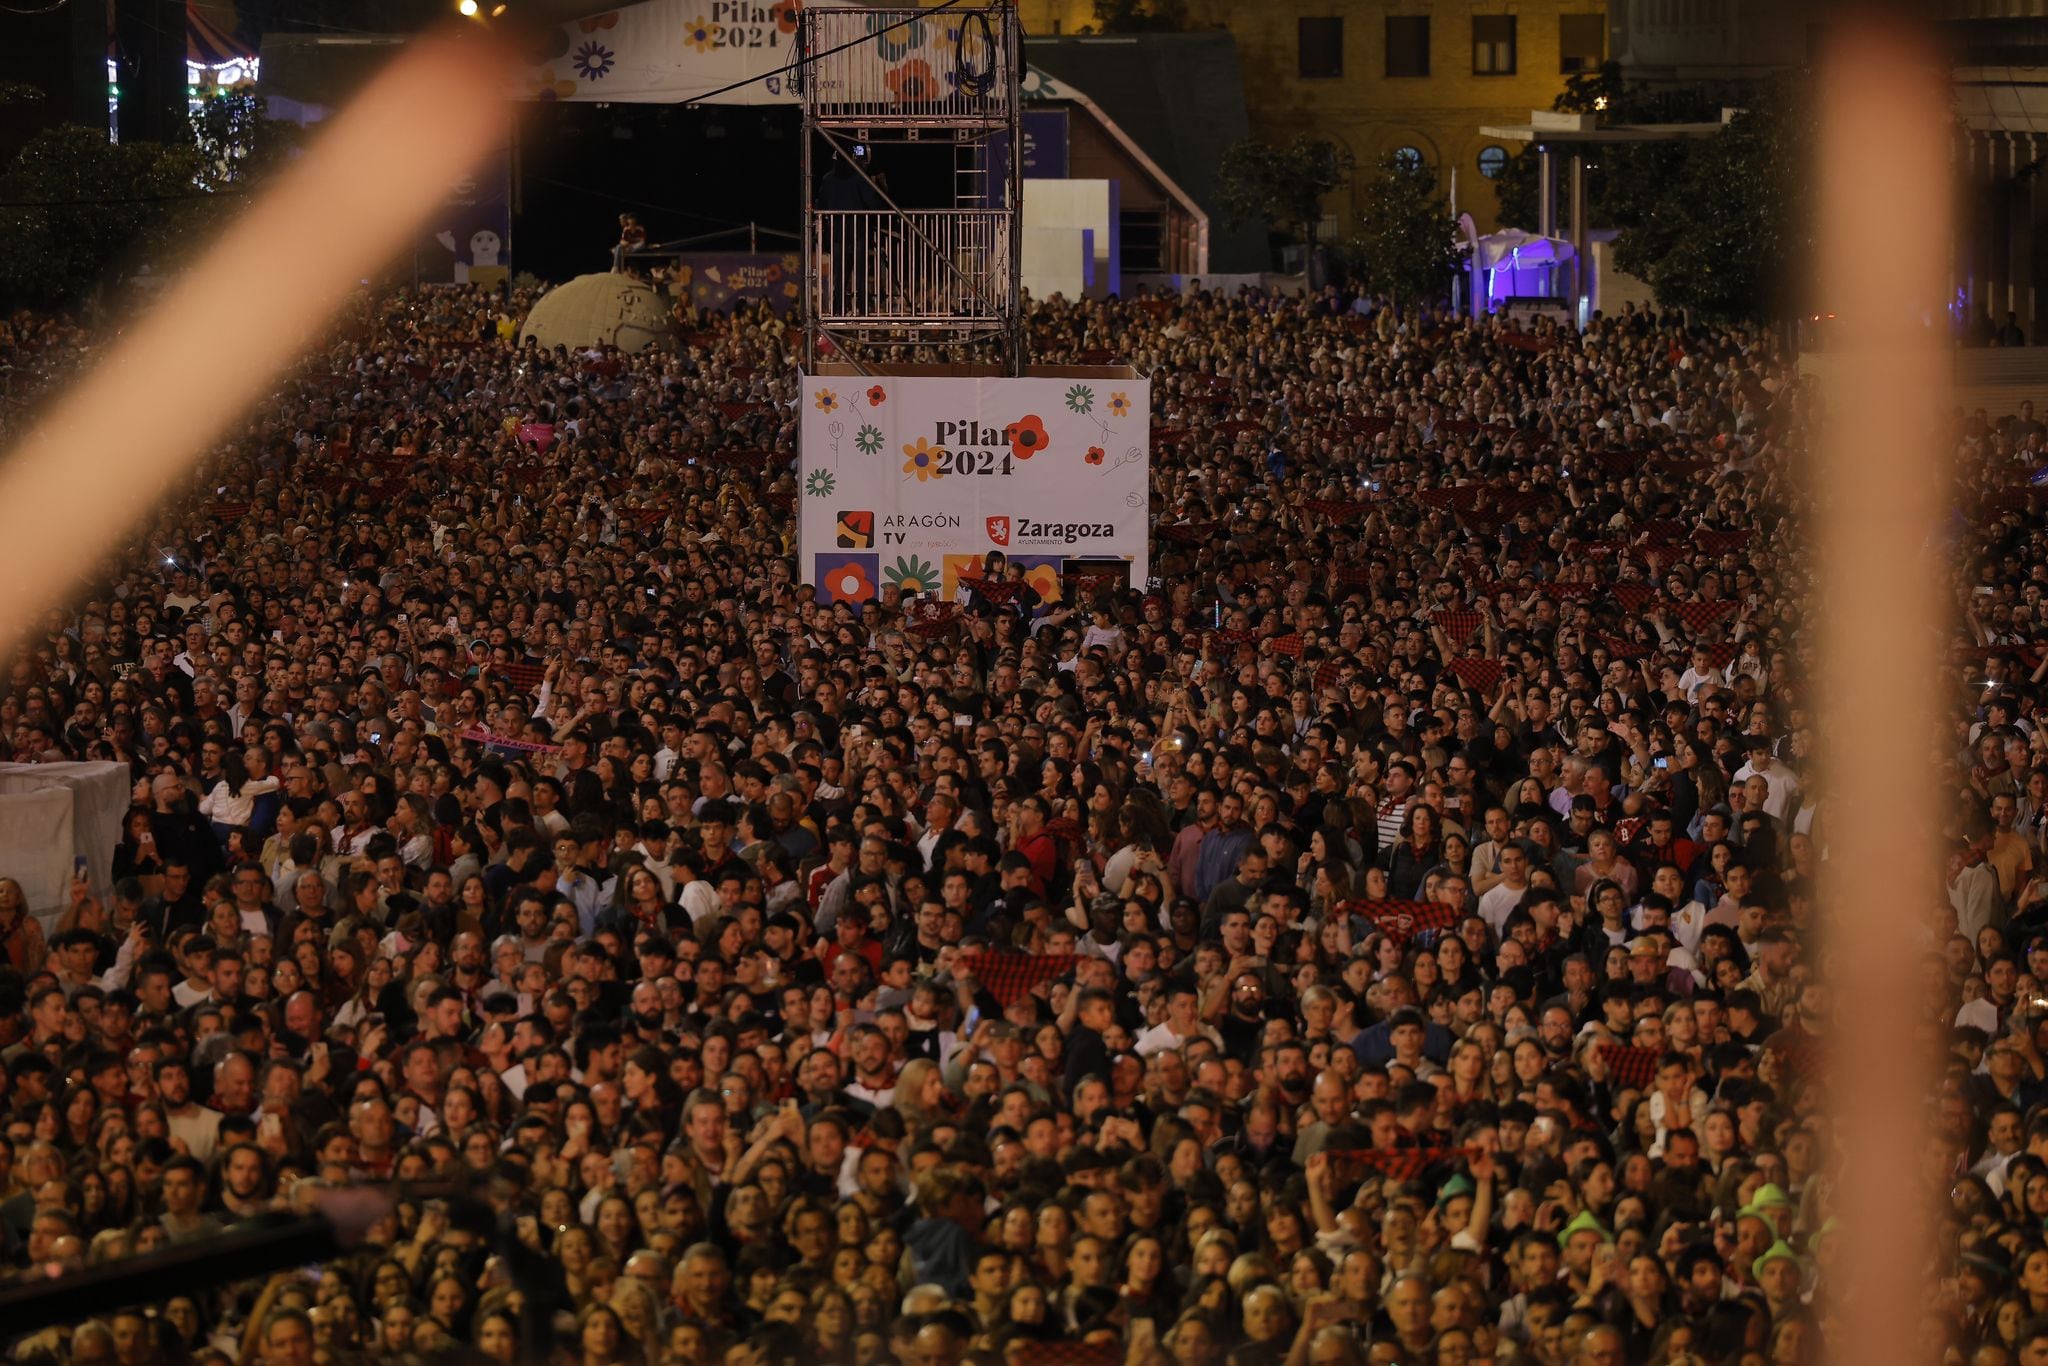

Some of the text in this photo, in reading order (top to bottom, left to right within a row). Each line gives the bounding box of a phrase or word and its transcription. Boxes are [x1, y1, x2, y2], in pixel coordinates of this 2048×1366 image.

[712, 0, 781, 22] Pilar
[713, 28, 780, 48] 2024
[935, 420, 1018, 446] Pilar
[936, 450, 1015, 475] 2024
[883, 511, 960, 528] ARAGÓN
[883, 533, 906, 545] TV
[1017, 519, 1114, 544] Zaragoza
